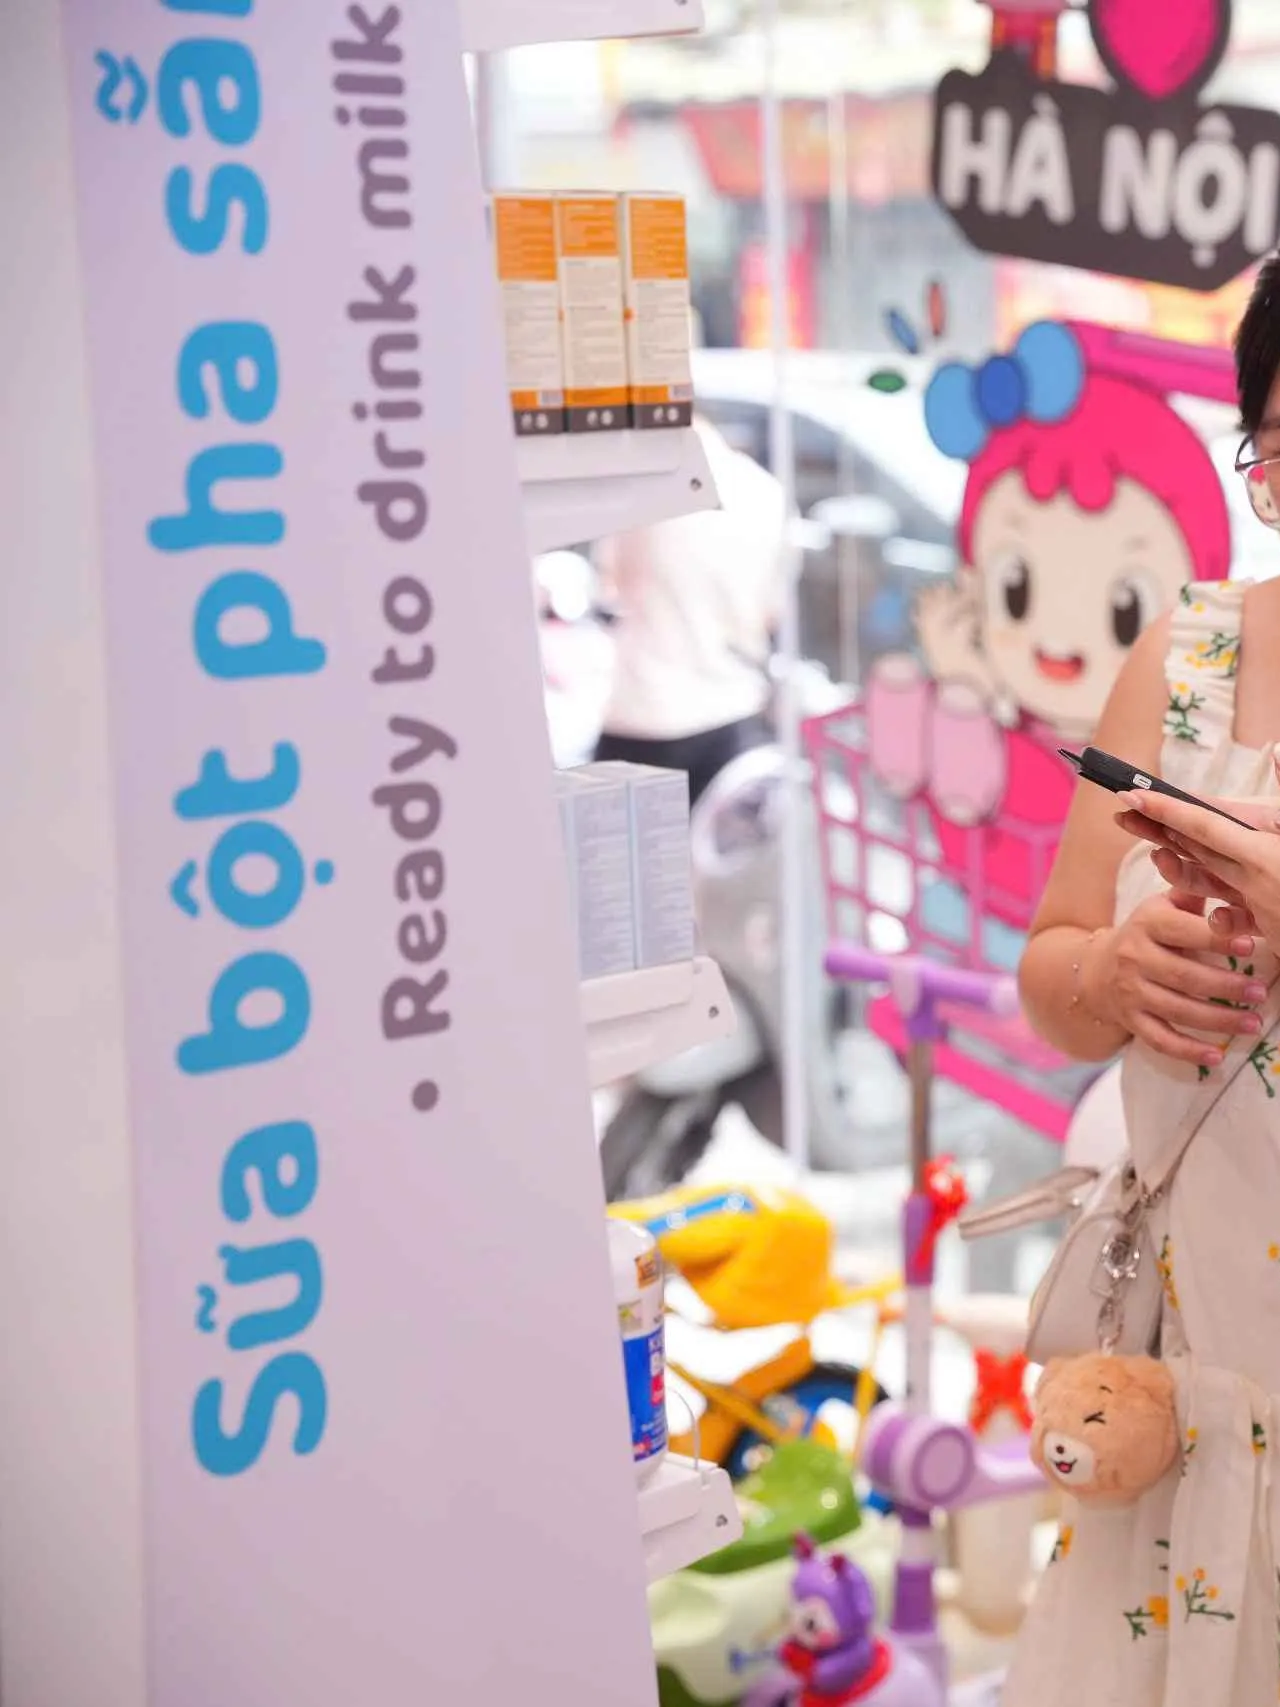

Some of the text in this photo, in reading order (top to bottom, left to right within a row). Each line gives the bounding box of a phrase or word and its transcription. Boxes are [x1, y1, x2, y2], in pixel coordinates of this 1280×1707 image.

[940, 92, 1280, 269] HÀ NỘI
[146, 320, 327, 681] pha
[329, 3, 458, 1041] Ready to drink milk
[170, 742, 334, 1076] bột
[192, 1121, 328, 1477] Sữa
